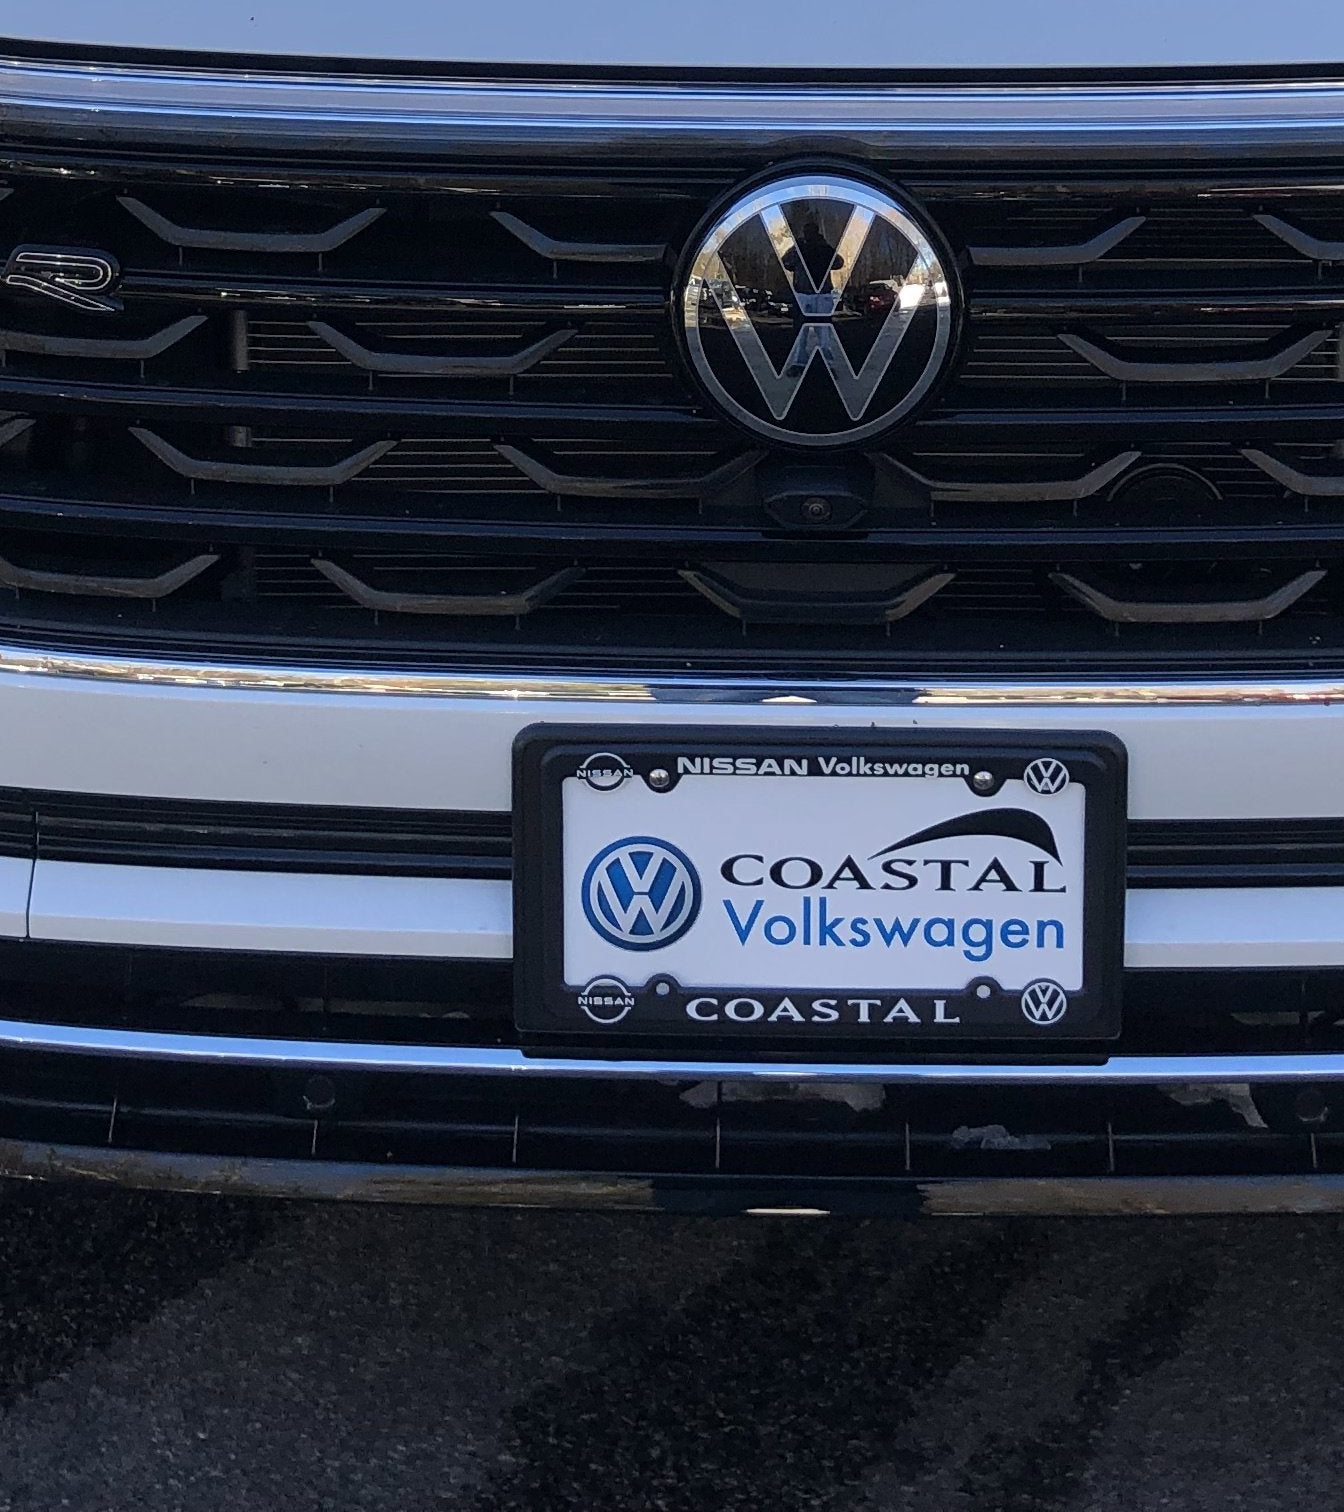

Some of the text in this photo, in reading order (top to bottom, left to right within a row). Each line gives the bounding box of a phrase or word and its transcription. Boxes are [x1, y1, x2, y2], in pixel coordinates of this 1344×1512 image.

[576, 767, 634, 779] NISSAN
[677, 756, 971, 779] NISSAN Volkswagen
[720, 854, 1067, 893] COASTAL
[722, 896, 1064, 962] Volkswagen
[577, 995, 636, 1007] NISSAN
[685, 998, 961, 1024] COASTAL
